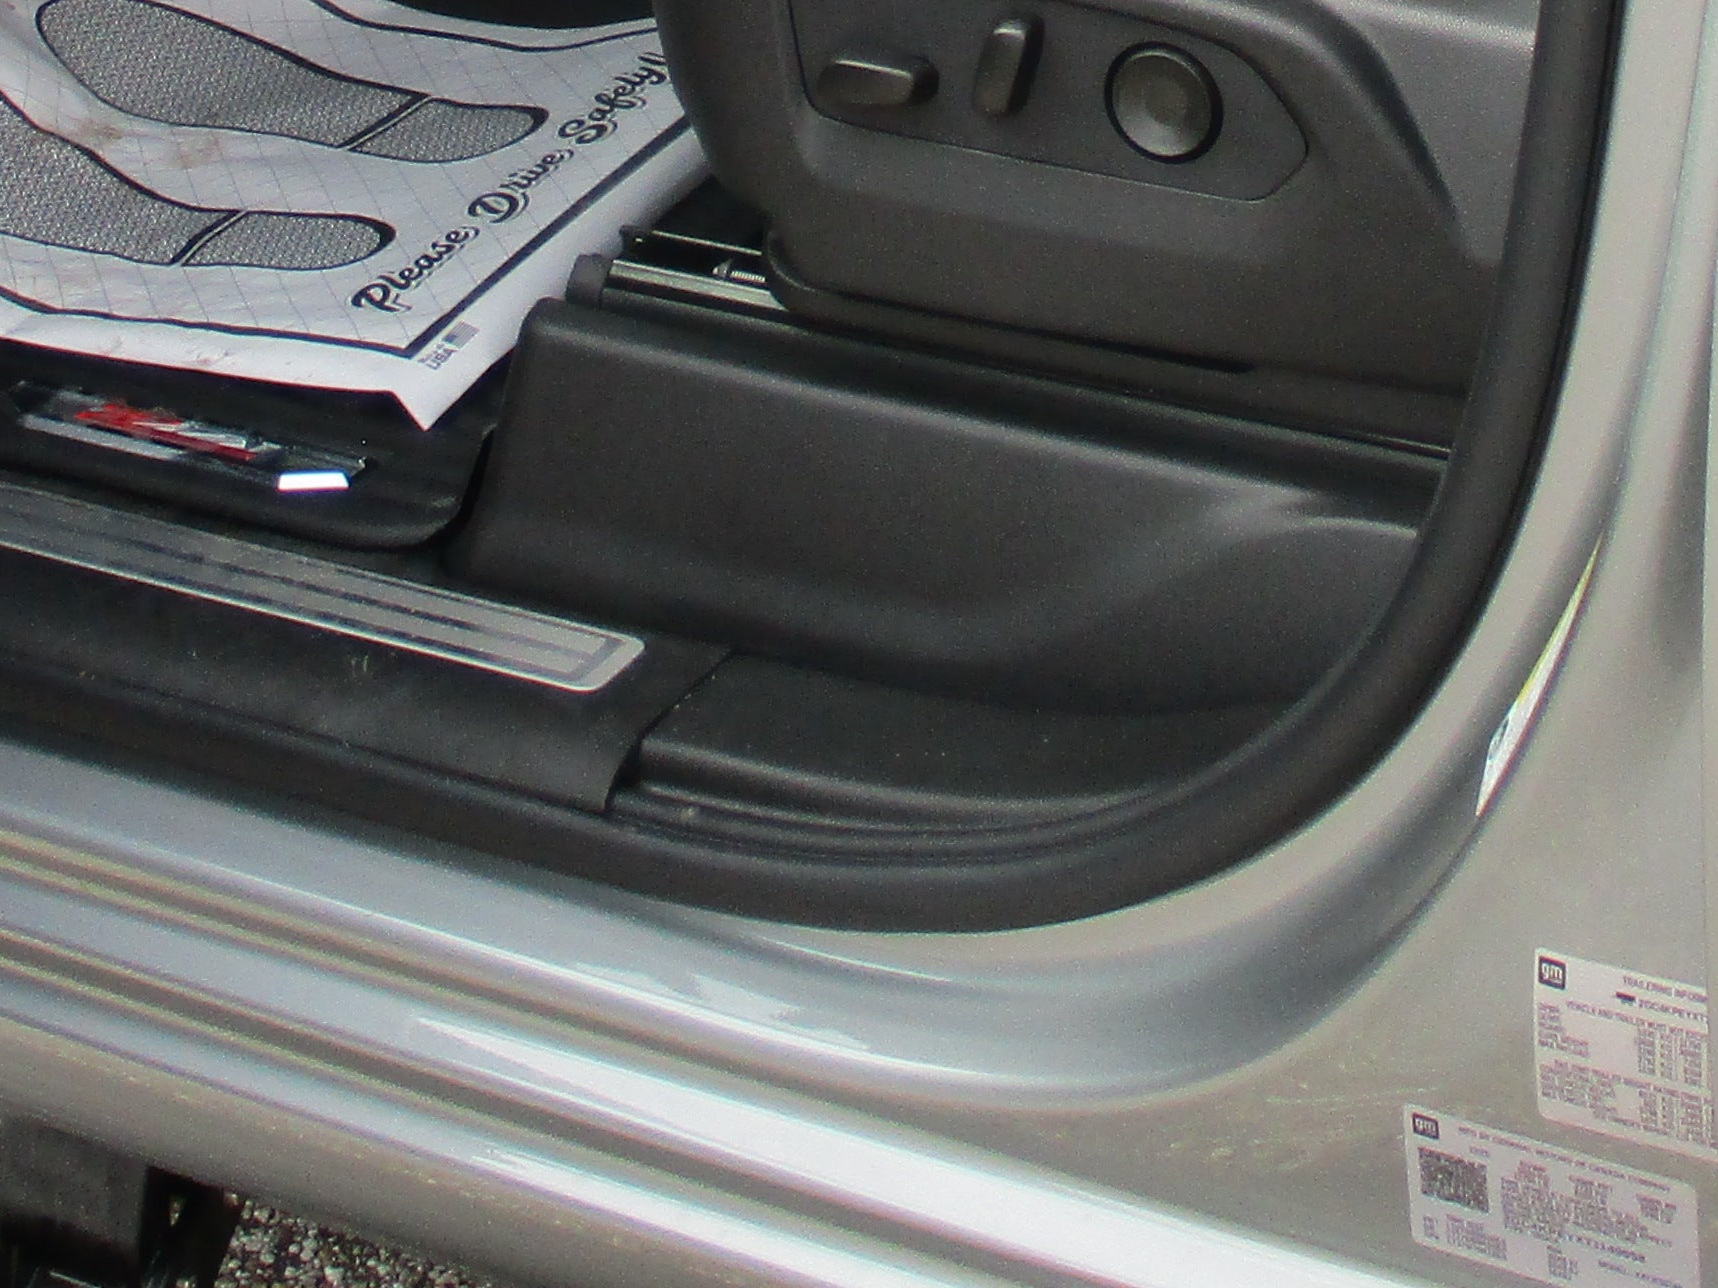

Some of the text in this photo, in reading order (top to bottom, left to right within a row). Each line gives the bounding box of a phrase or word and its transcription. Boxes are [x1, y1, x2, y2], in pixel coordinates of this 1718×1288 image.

[349, 226, 480, 312] Please
[468, 149, 574, 223] Drive
[1540, 961, 1564, 986] gm
